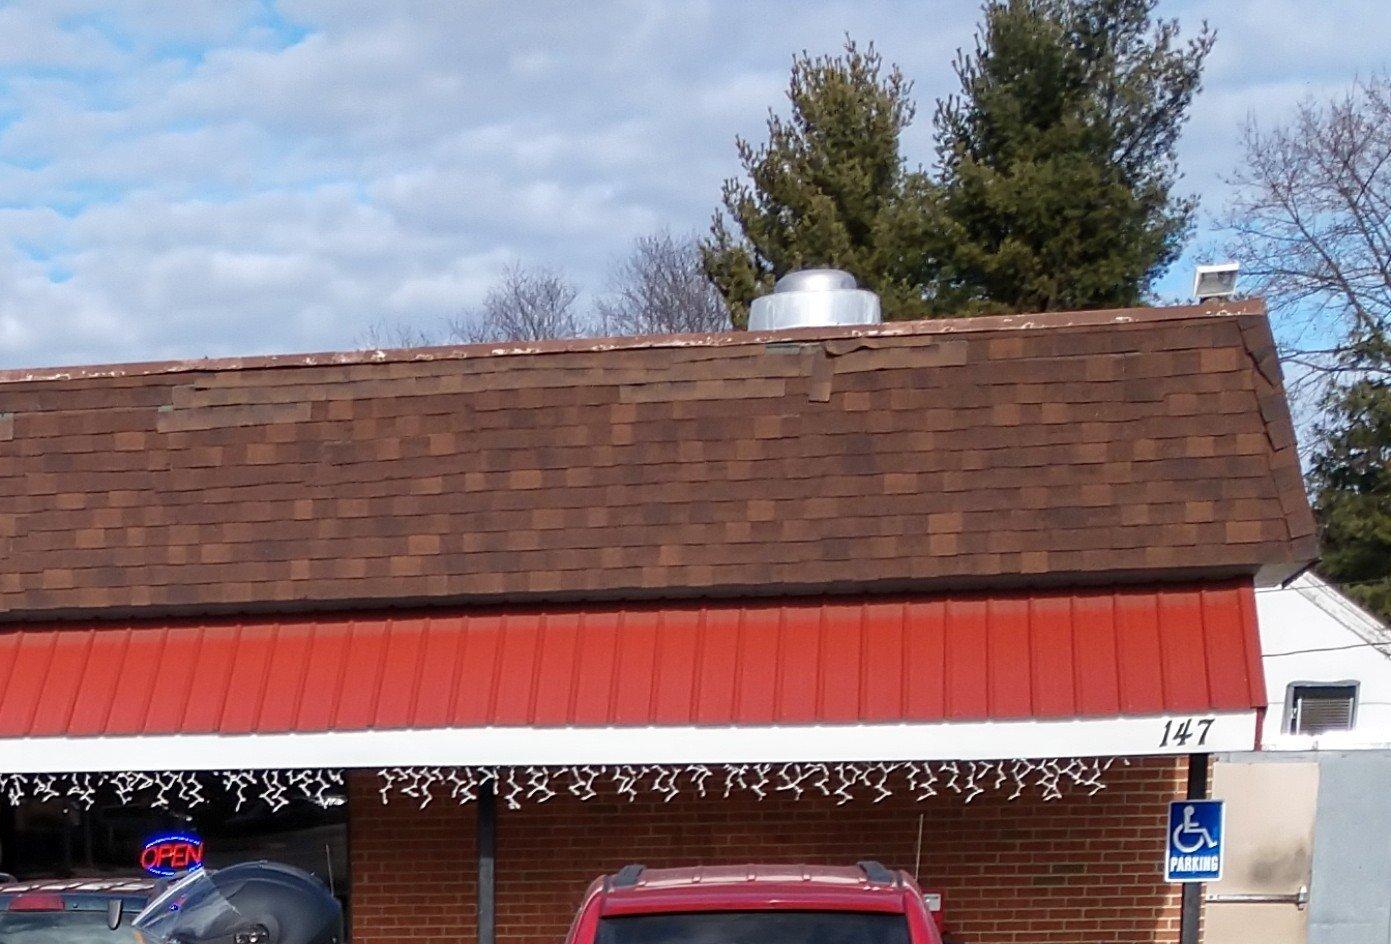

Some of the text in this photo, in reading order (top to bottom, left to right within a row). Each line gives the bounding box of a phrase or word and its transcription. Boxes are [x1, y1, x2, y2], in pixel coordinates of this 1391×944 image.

[1159, 718, 1215, 748] 147
[141, 842, 204, 869] OPEN
[1170, 856, 1218, 872] PARKING
